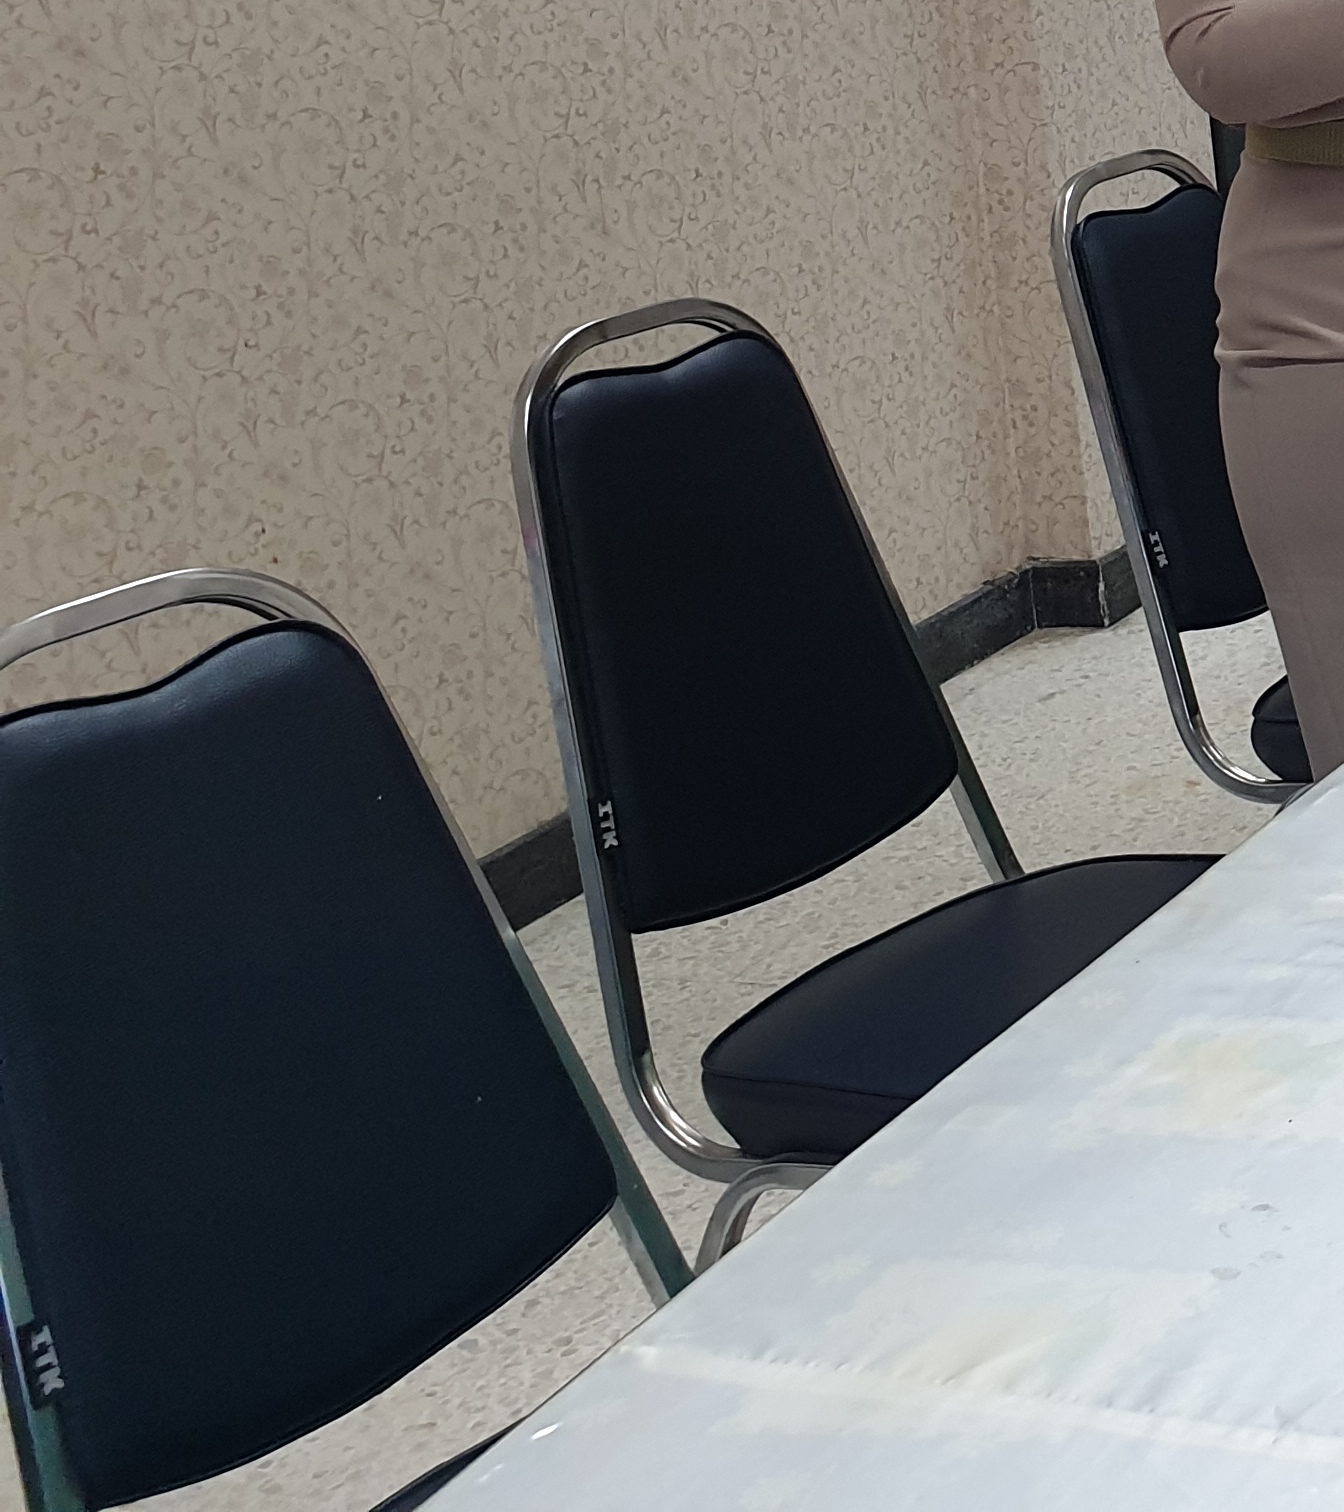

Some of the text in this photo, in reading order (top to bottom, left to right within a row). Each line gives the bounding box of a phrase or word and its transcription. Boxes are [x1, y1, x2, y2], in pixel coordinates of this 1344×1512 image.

[1148, 531, 1169, 569] ITK
[597, 800, 619, 849] ITK
[31, 1325, 66, 1396] ITK
